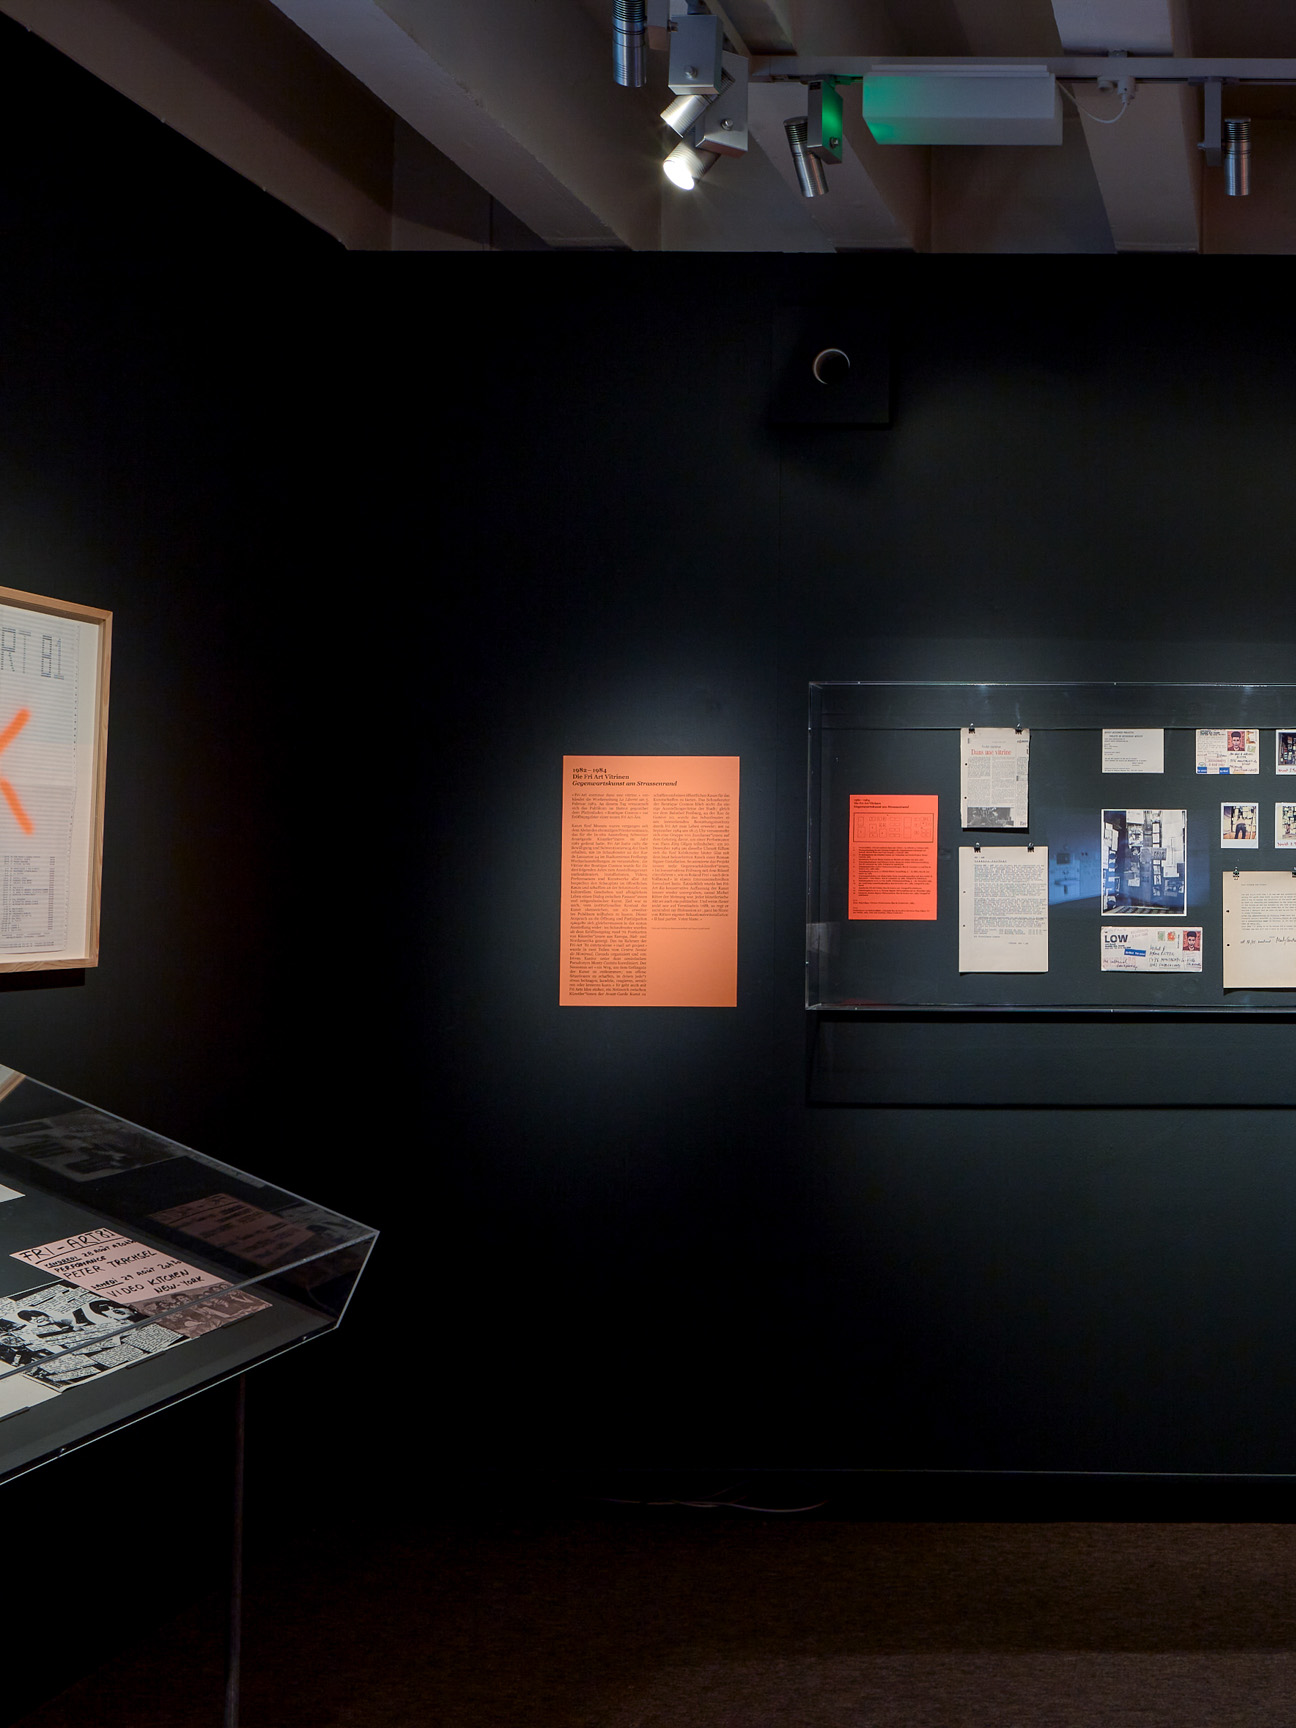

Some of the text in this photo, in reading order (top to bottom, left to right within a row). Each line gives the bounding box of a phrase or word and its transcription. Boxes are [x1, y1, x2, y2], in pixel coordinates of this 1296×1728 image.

[1104, 934, 1128, 943] LOW
[63, 1250, 158, 1279] PETER TRACHSEL
[106, 1269, 190, 1298] VIDEO KITCHEN
[153, 1276, 206, 1294] NEW-YORK
